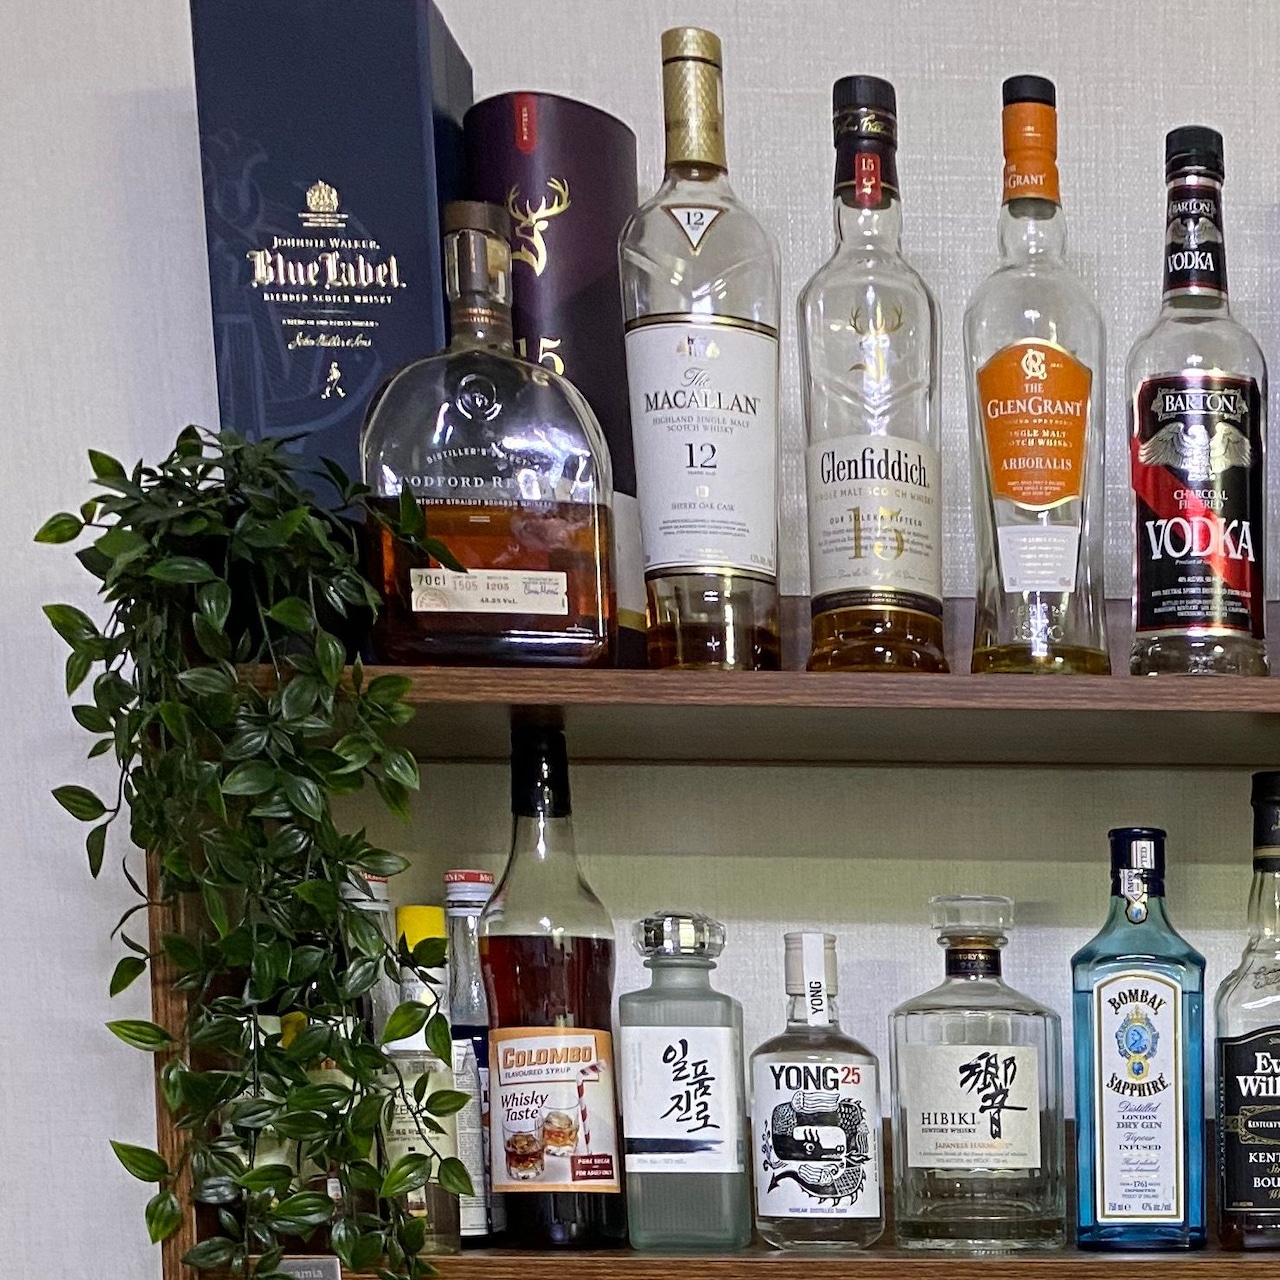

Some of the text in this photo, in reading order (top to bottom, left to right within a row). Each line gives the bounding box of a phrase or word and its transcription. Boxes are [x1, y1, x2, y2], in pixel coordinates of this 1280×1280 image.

[861, 158, 875, 171] 15
[685, 211, 705, 226] 12
[273, 236, 326, 249] JOHNNIE
[246, 249, 320, 288] Blue
[1167, 250, 1215, 273] VODKA
[312, 294, 349, 303] SCOTCH
[353, 295, 392, 304] WHISKY
[1024, 383, 1044, 393] THE
[644, 389, 759, 416] MACALLAN
[730, 418, 750, 429] MALT
[684, 443, 718, 469] 12
[1002, 456, 1073, 471] ARBORALIS
[1174, 489, 1228, 500] CHARCOAL
[830, 514, 844, 525] OUR
[847, 506, 904, 560] 15
[1145, 516, 1256, 562] VODKA
[809, 980, 824, 1015] YONG
[1107, 988, 1167, 1015] BOMBAY
[502, 1045, 592, 1069] COLOMBO
[545, 1066, 571, 1076] SYRUP
[769, 1065, 861, 1091] YONG 25
[1106, 1072, 1170, 1097] SAPPHIRE
[501, 1090, 549, 1109] Whisky
[505, 1107, 539, 1122] Taste
[921, 1112, 977, 1125] HIBIKI
[1116, 1121, 1162, 1129] DRY GIN
